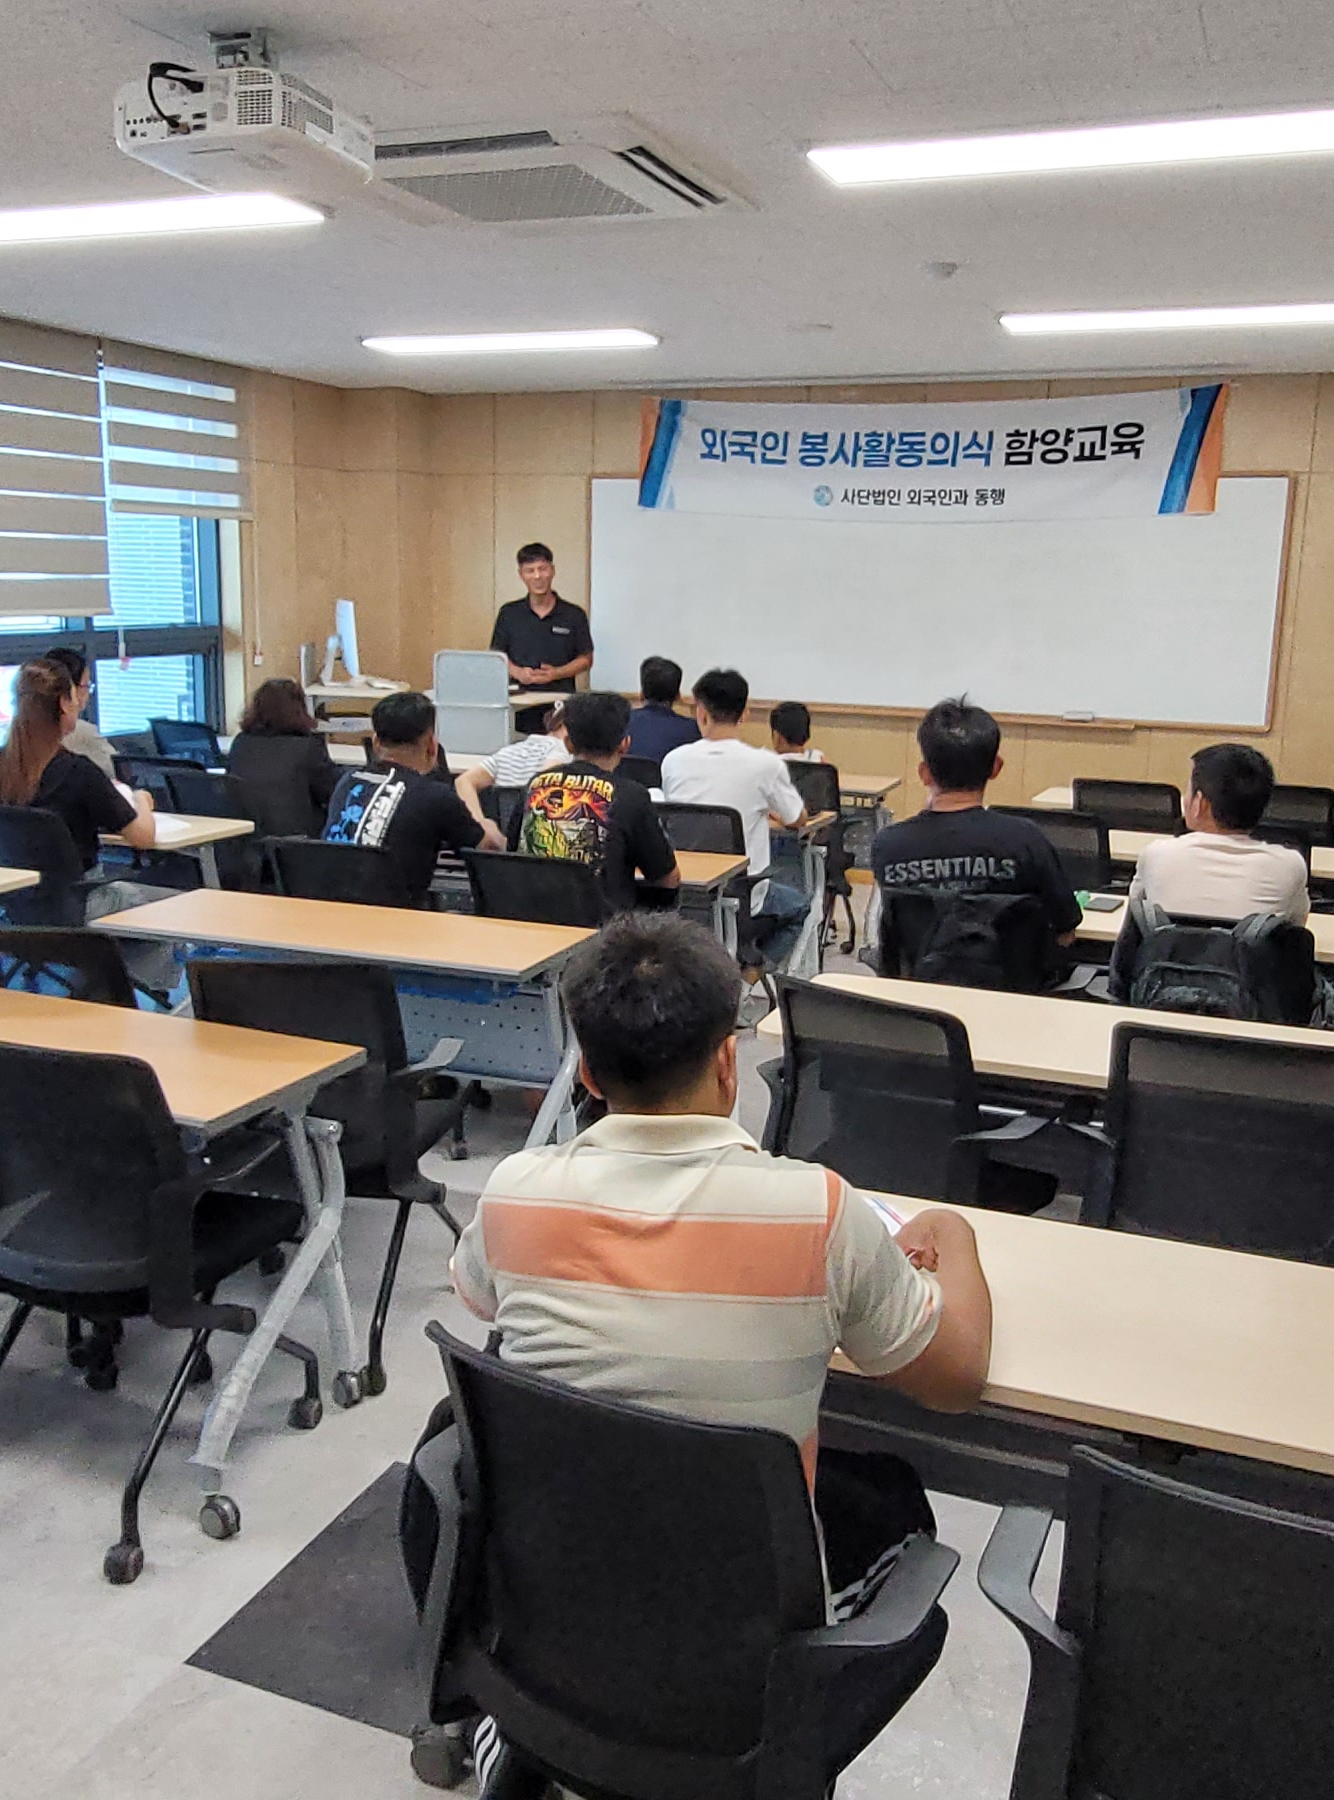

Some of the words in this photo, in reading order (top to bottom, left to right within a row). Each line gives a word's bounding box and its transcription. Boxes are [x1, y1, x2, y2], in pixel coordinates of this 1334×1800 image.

[699, 428, 790, 466] 외국인
[798, 430, 994, 468] 봉사활동의식
[1004, 422, 1146, 467] 함양교육
[840, 488, 902, 506] 사단법인
[906, 488, 969, 507] 외국인과
[974, 488, 1006, 507] 동행
[884, 856, 1016, 883] ESSENTIALS
